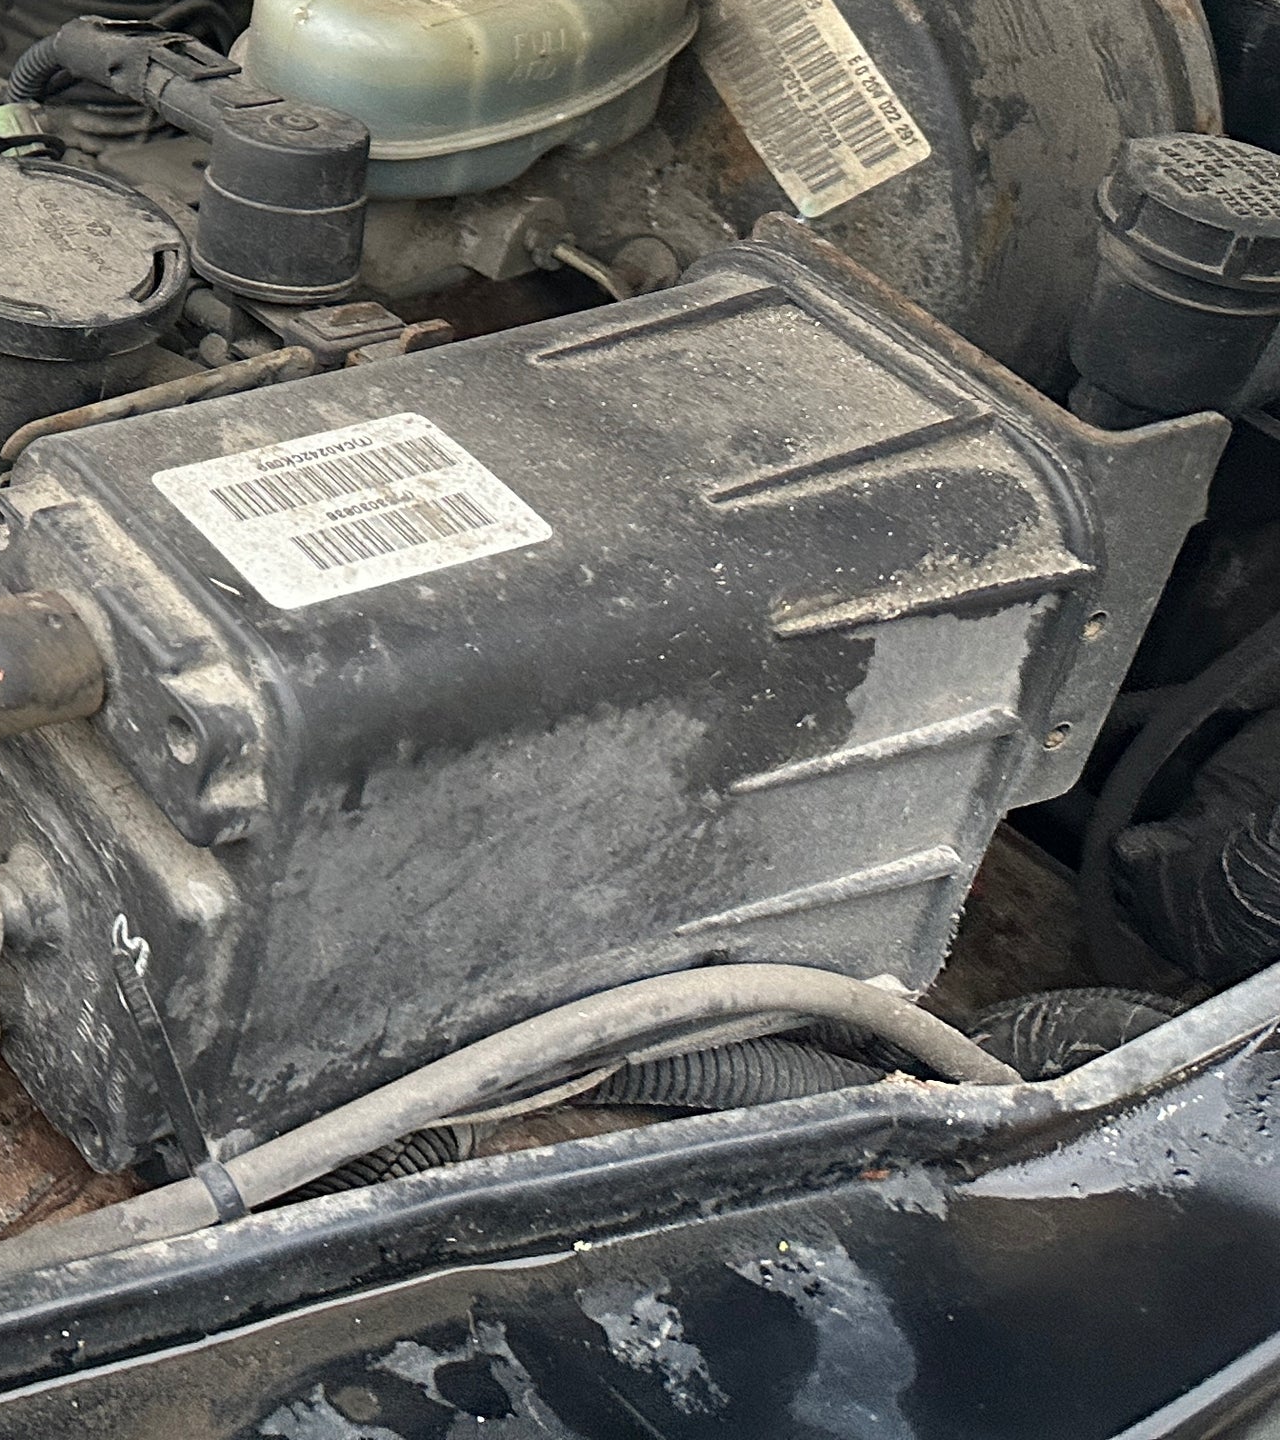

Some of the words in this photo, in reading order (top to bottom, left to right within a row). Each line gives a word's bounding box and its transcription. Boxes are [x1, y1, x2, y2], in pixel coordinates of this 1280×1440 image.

[848, 55, 862, 67] E
[880, 103, 901, 125] 022
[896, 124, 918, 147] 291
